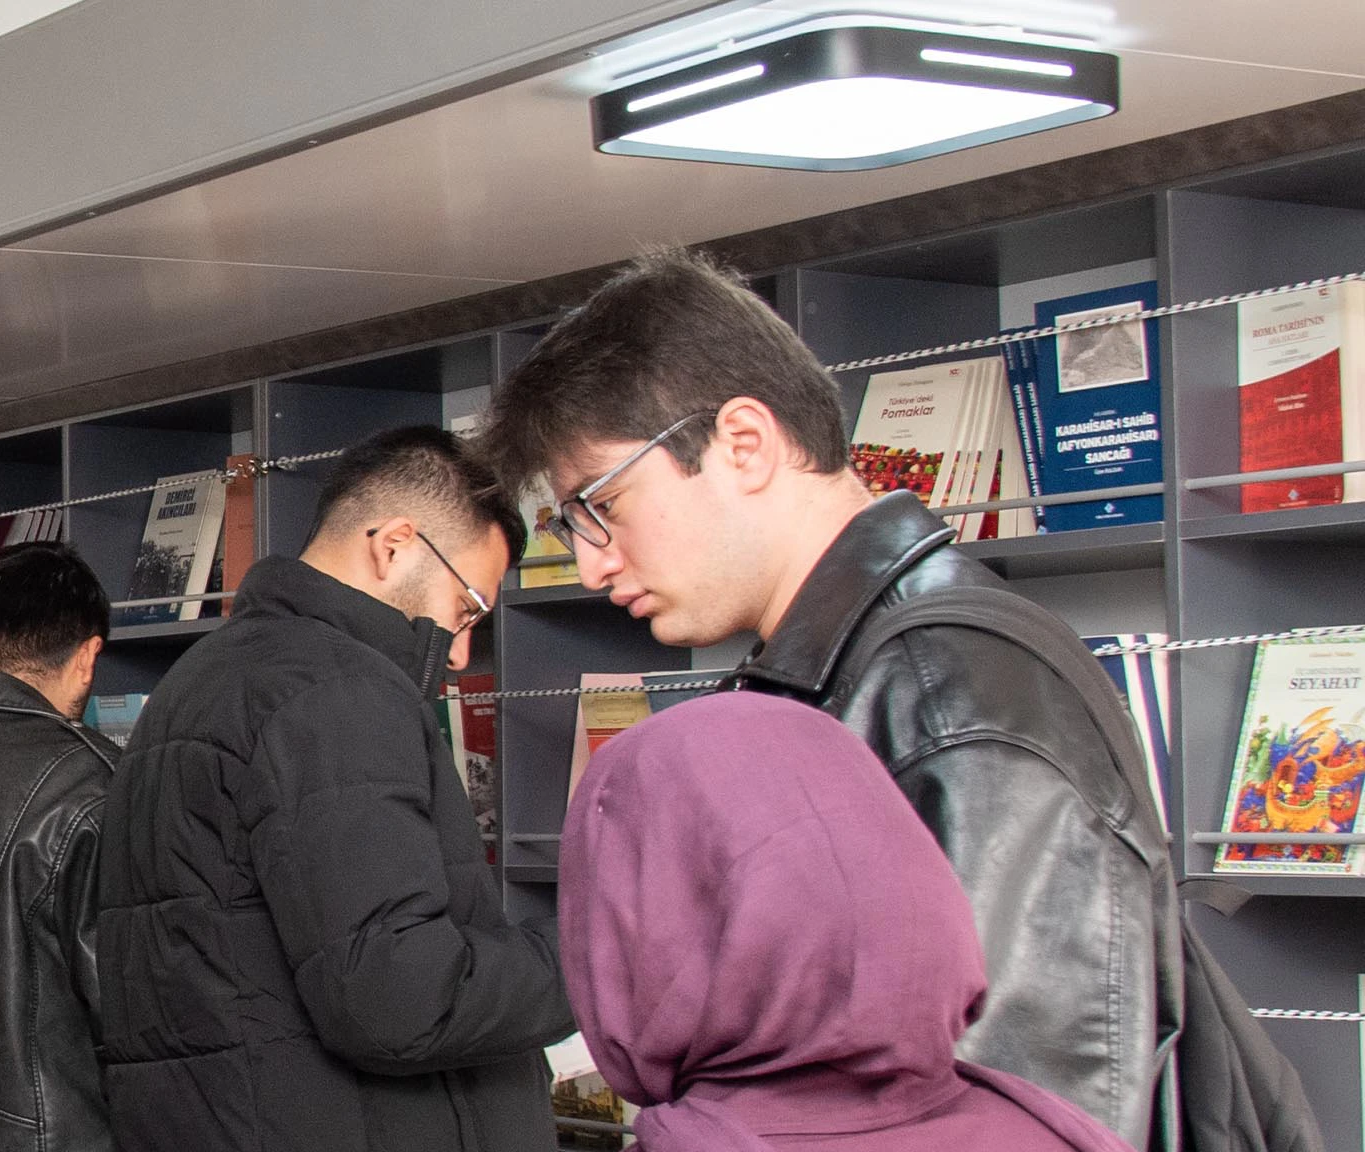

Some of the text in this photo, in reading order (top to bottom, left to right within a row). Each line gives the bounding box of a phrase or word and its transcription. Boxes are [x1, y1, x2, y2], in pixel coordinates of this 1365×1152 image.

[880, 405, 936, 420] Pomaklar
[1055, 419, 1120, 437] KARAHİSAR-I
[1123, 412, 1157, 428] SAHİB
[1084, 446, 1133, 464] SANCAĞI
[1289, 677, 1362, 690] SEYAHAT
